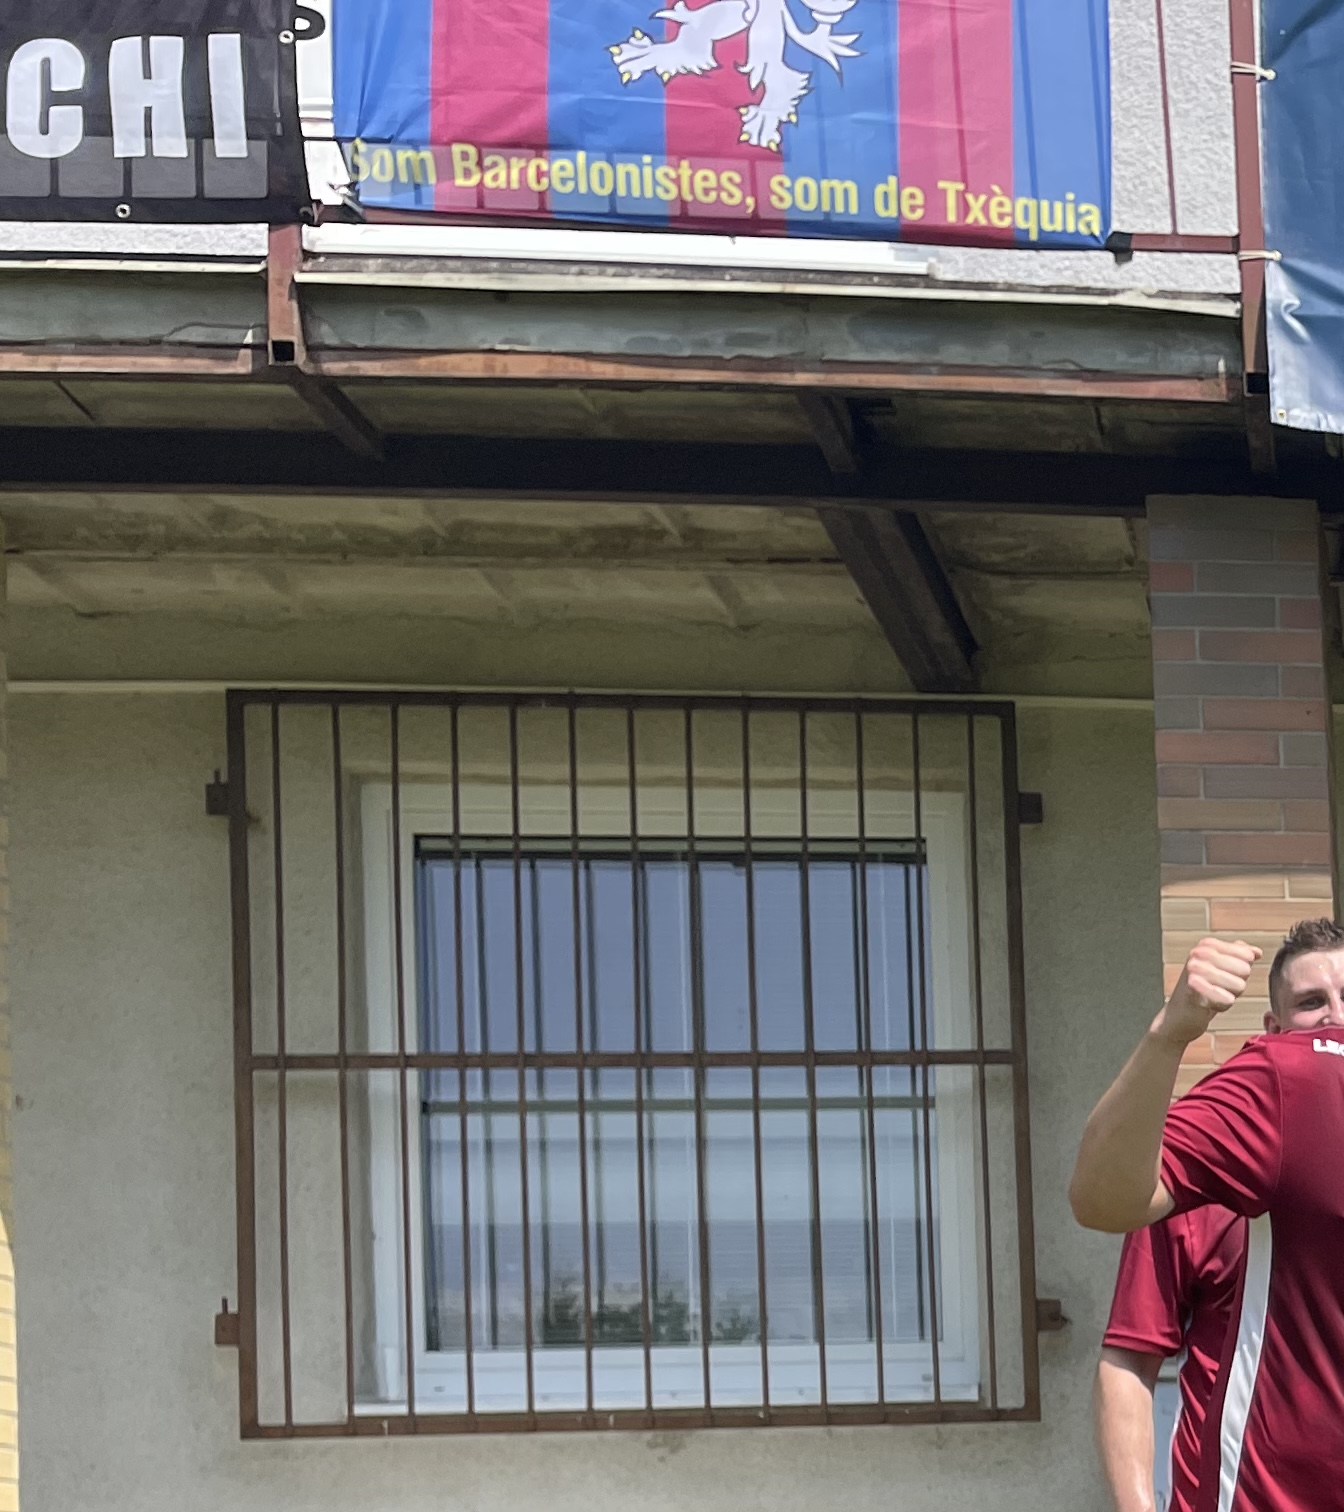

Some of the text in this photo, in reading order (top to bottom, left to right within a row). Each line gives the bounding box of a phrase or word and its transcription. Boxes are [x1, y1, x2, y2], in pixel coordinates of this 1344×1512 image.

[6, 33, 248, 158] CHI
[450, 142, 756, 214] Barcelonistes,
[770, 173, 858, 216] som
[874, 175, 925, 221] de
[937, 179, 1102, 241] Txèquia
